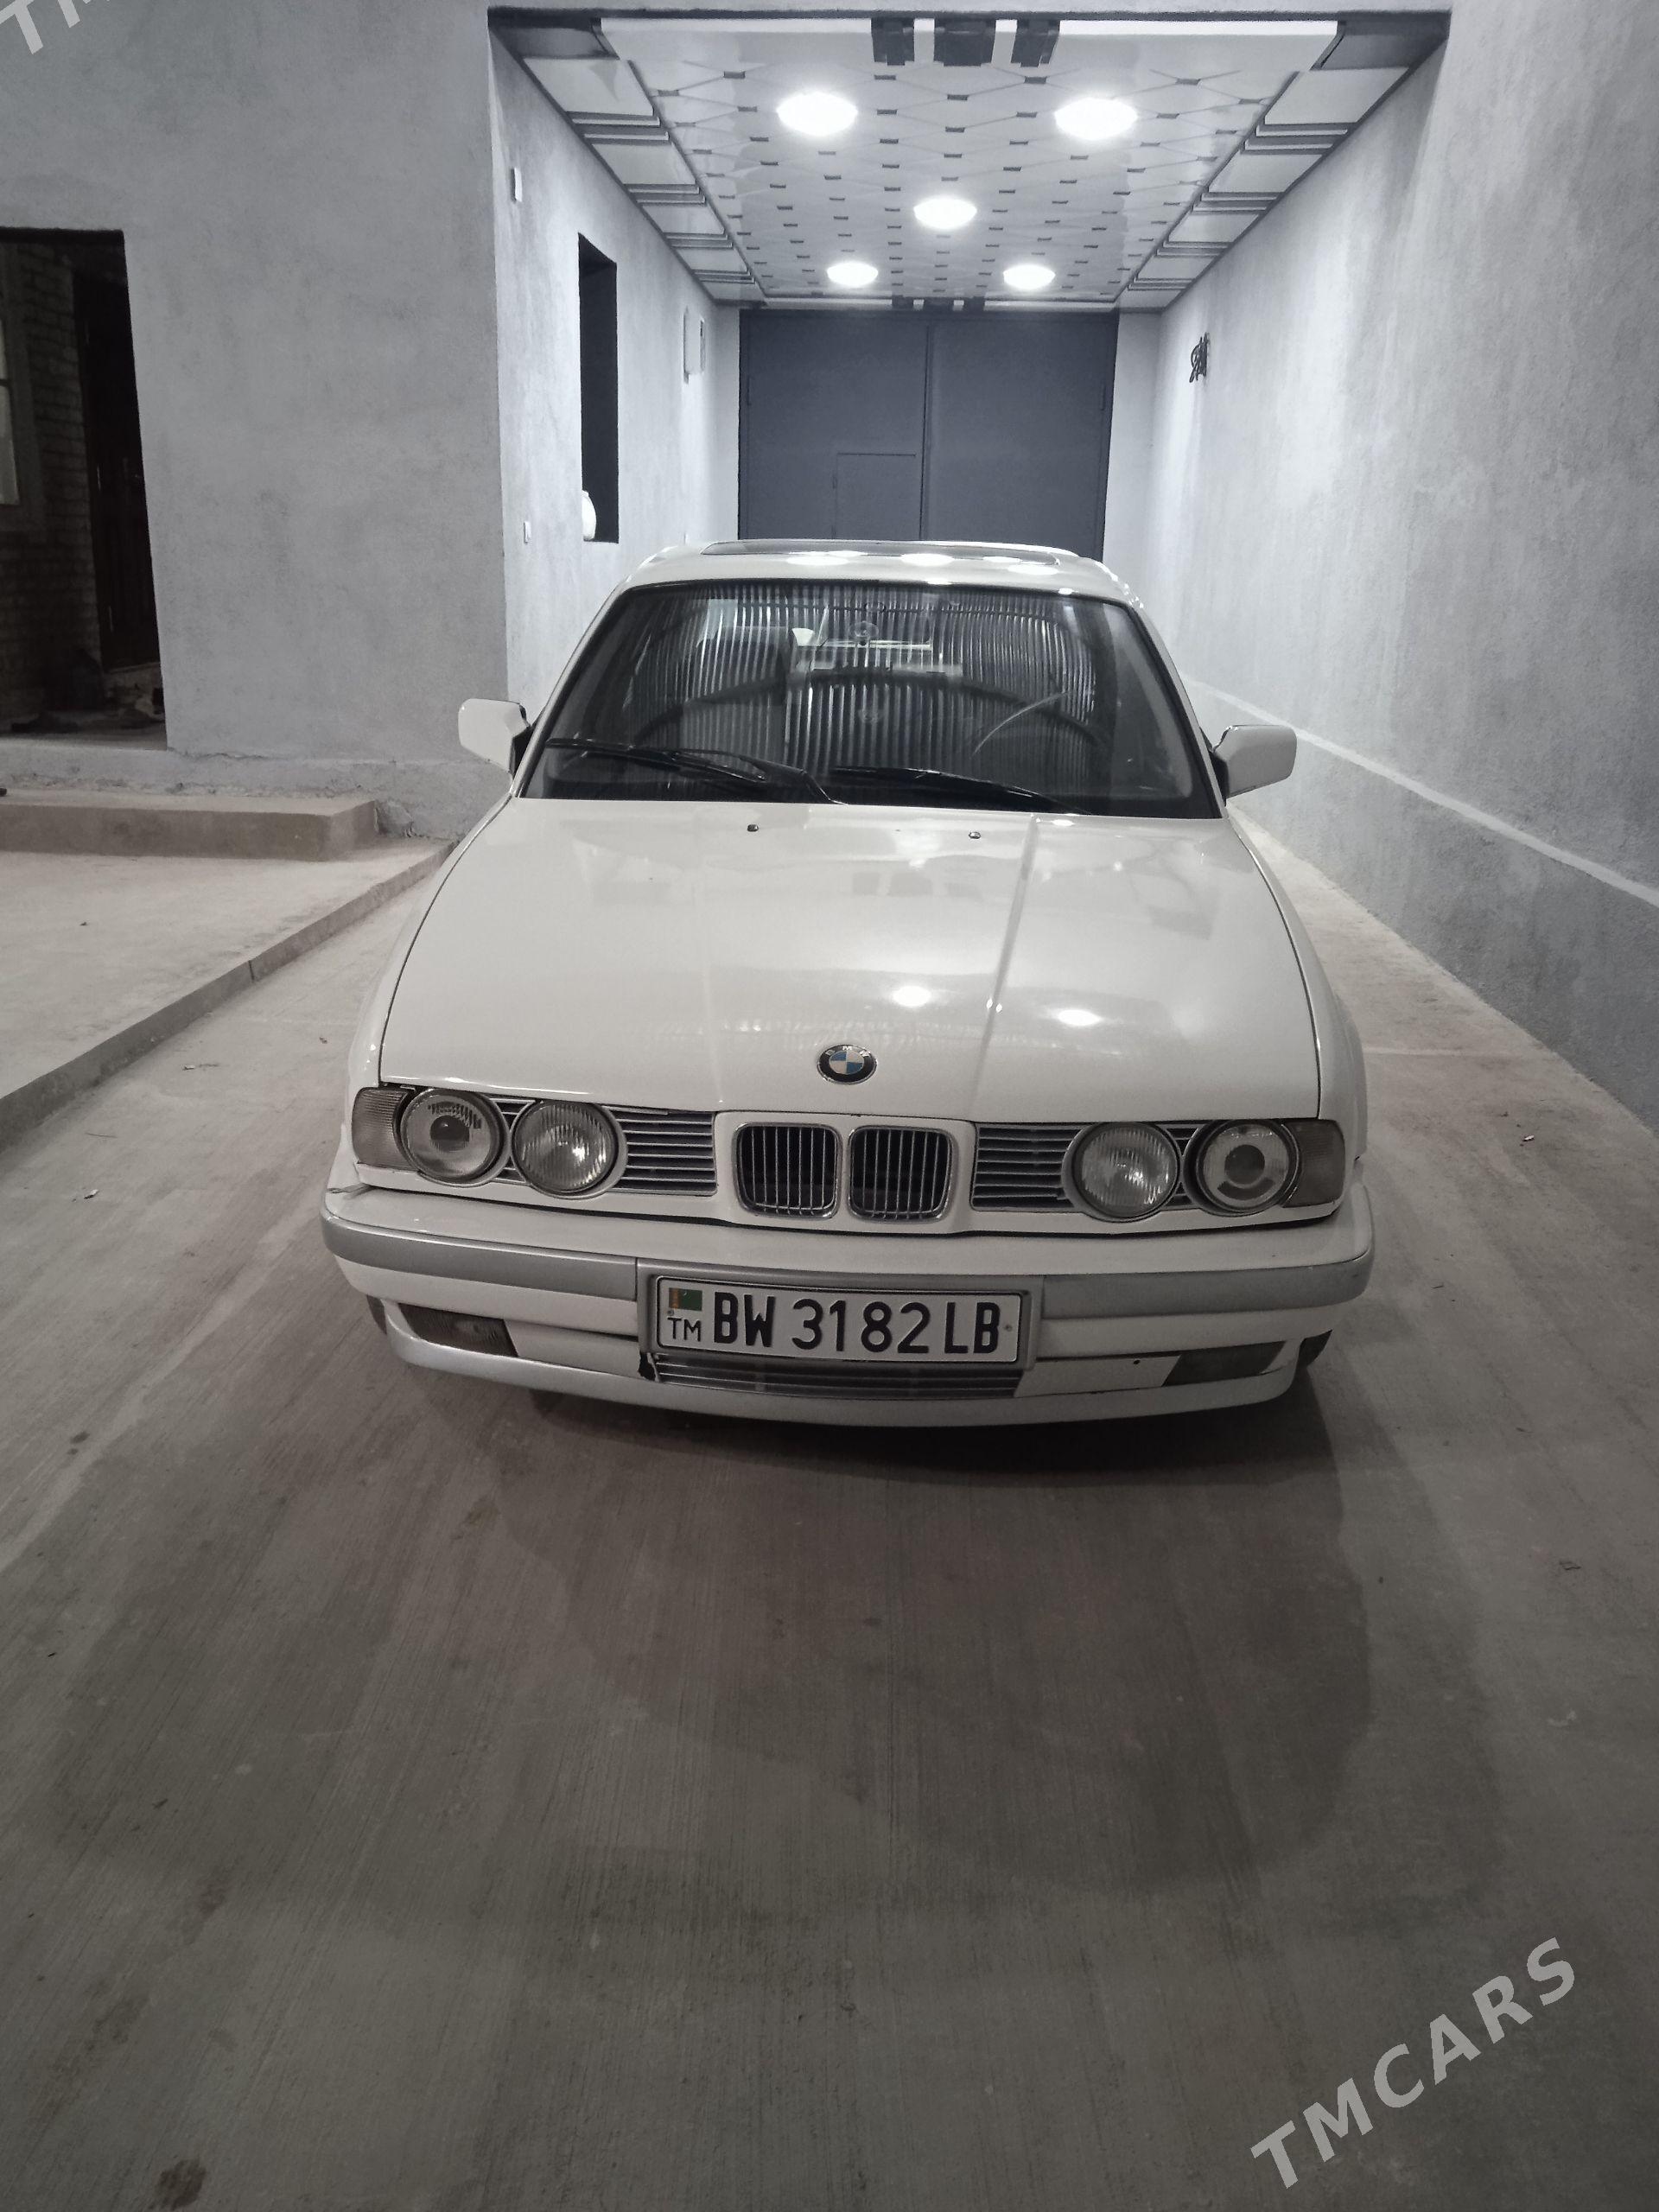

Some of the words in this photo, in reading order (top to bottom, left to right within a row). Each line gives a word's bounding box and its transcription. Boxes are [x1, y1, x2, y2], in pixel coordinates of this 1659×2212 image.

[668, 1317, 702, 1342] TM
[714, 1292, 775, 1347] BW
[792, 1298, 930, 1354] 3182
[944, 1301, 1001, 1354] LB
